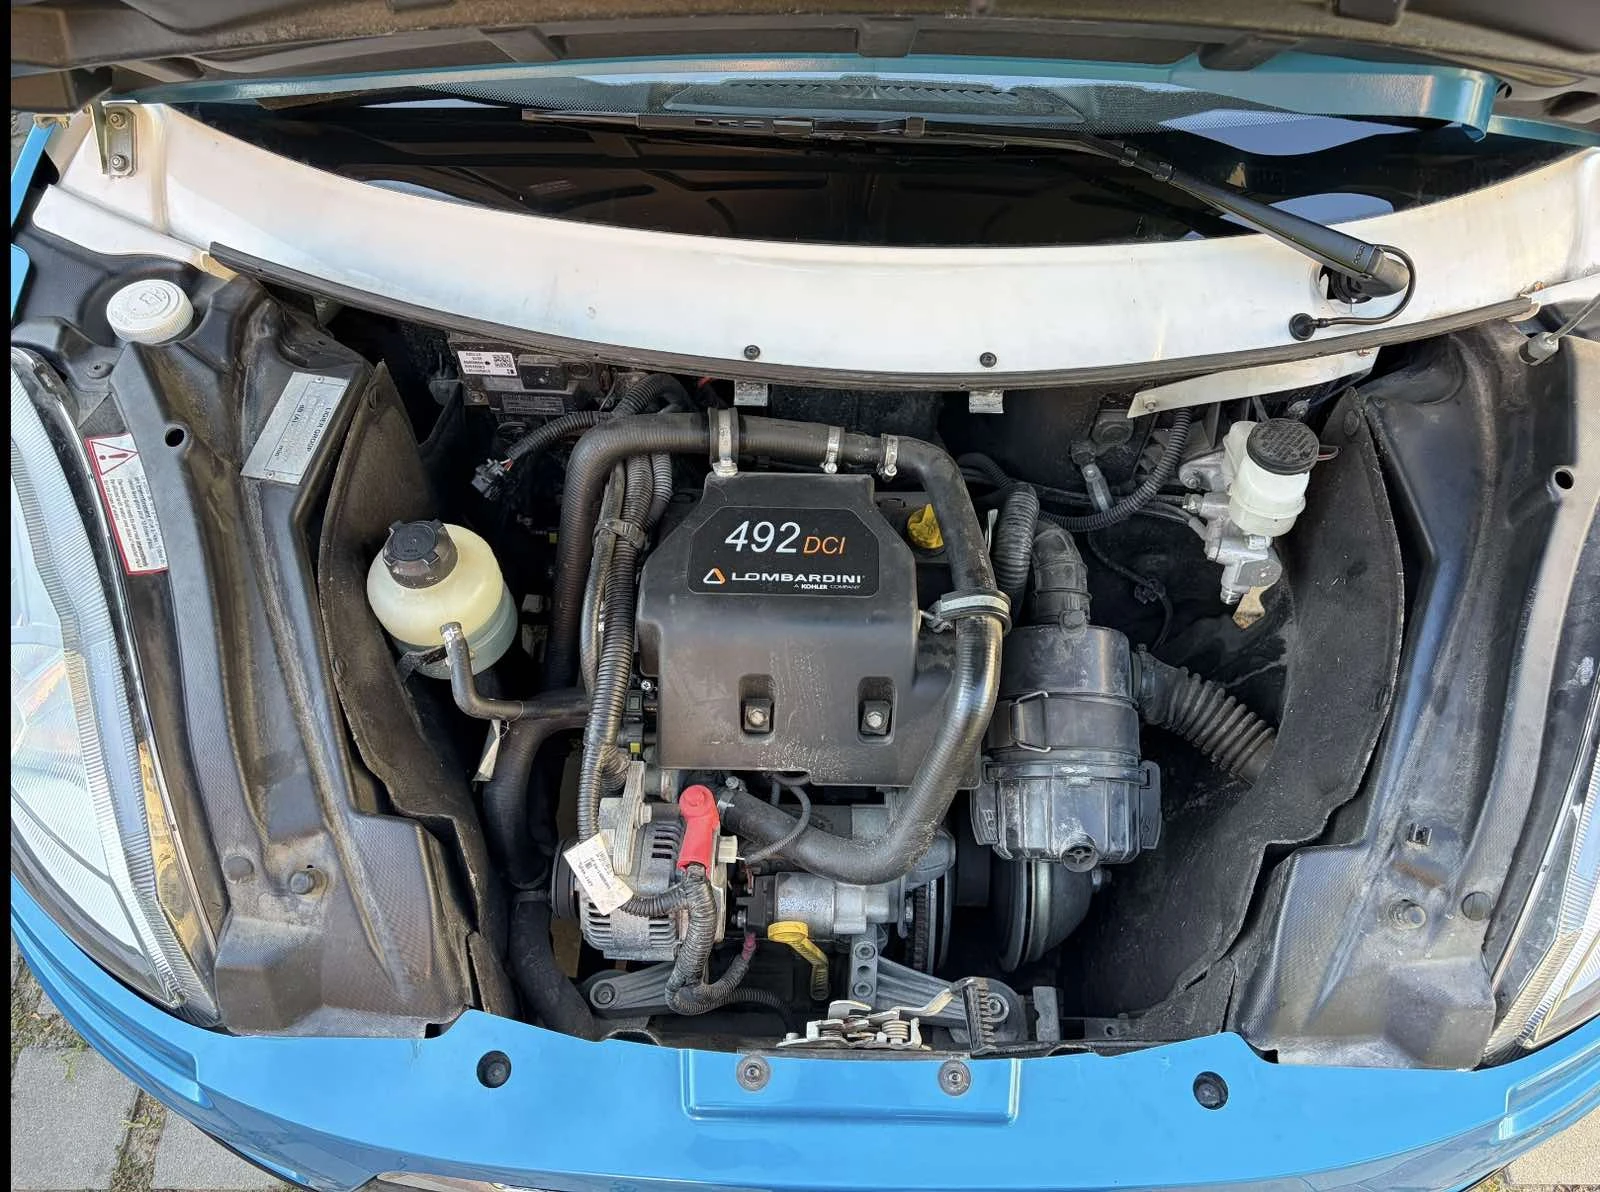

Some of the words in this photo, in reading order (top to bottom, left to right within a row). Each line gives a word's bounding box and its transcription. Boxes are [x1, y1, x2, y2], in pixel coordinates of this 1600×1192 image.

[307, 429, 321, 452] GROUP
[725, 520, 801, 553] 492
[803, 536, 846, 554] DCI
[731, 572, 862, 583] LOMBARDINI
